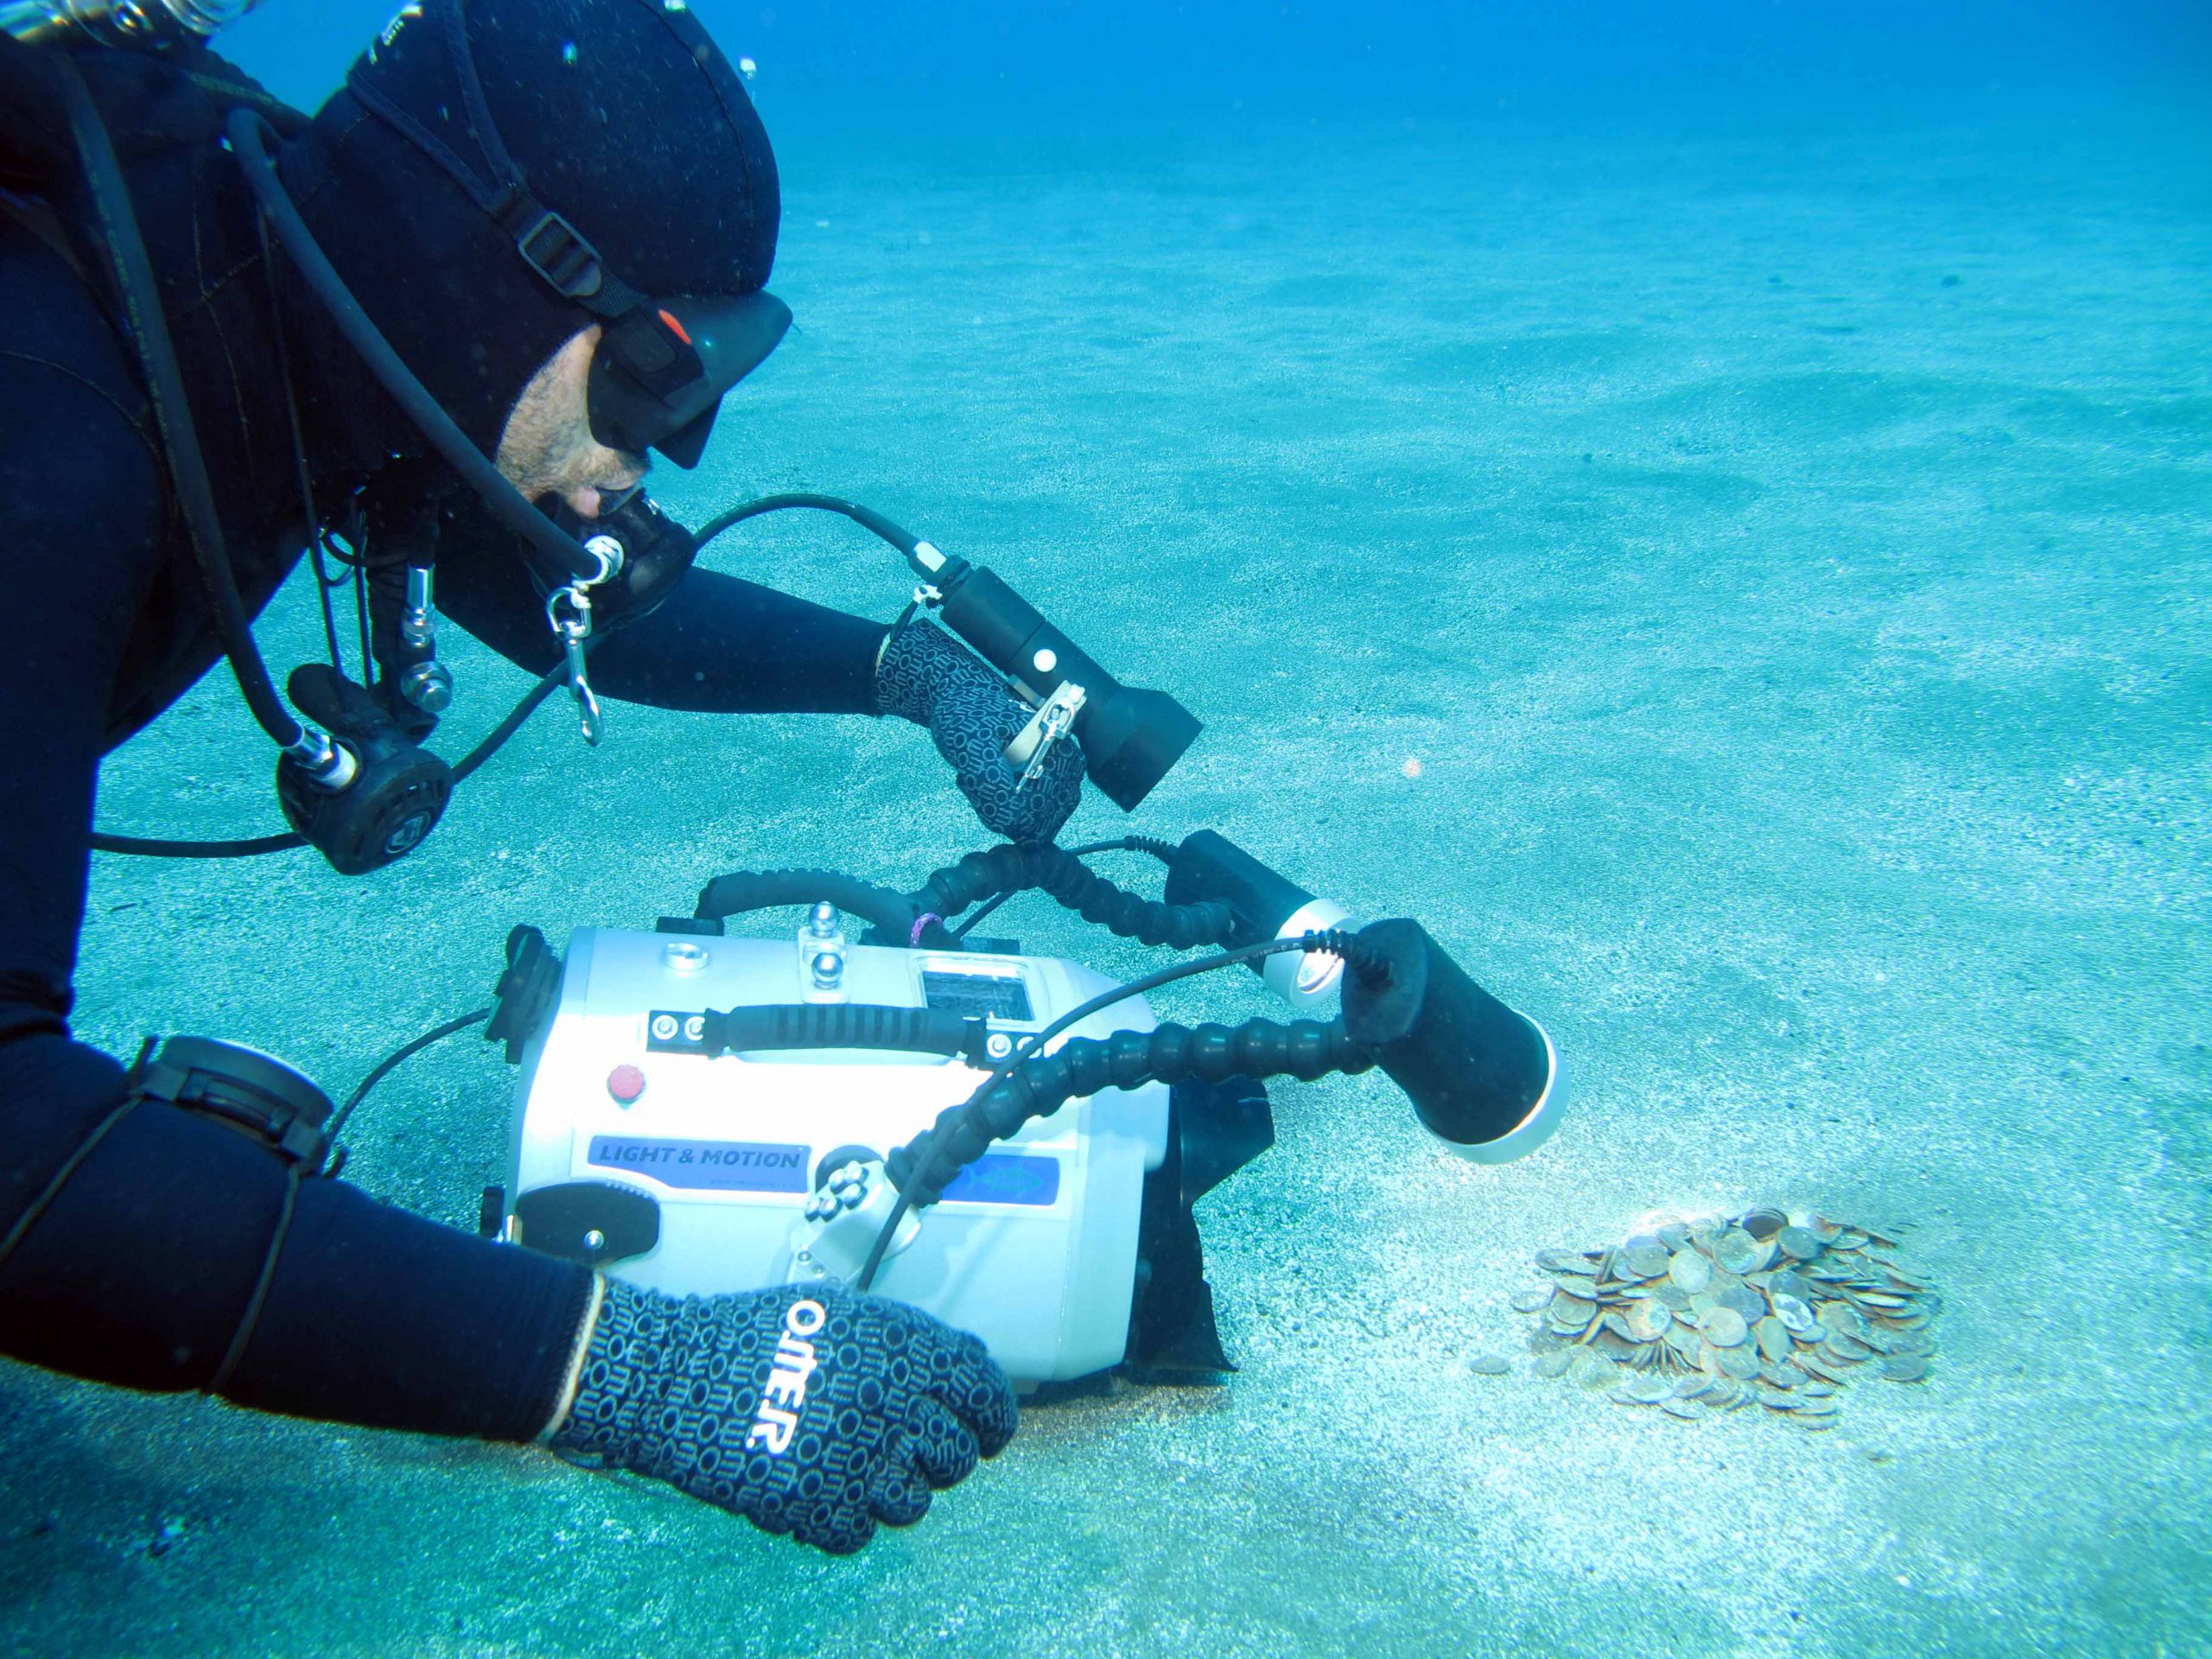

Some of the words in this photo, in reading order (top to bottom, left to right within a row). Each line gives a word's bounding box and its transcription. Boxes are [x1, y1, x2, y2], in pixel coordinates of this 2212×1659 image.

[600, 1145, 677, 1163] LIGHT
[678, 1148, 695, 1165] &
[700, 1149, 801, 1168] MOTION
